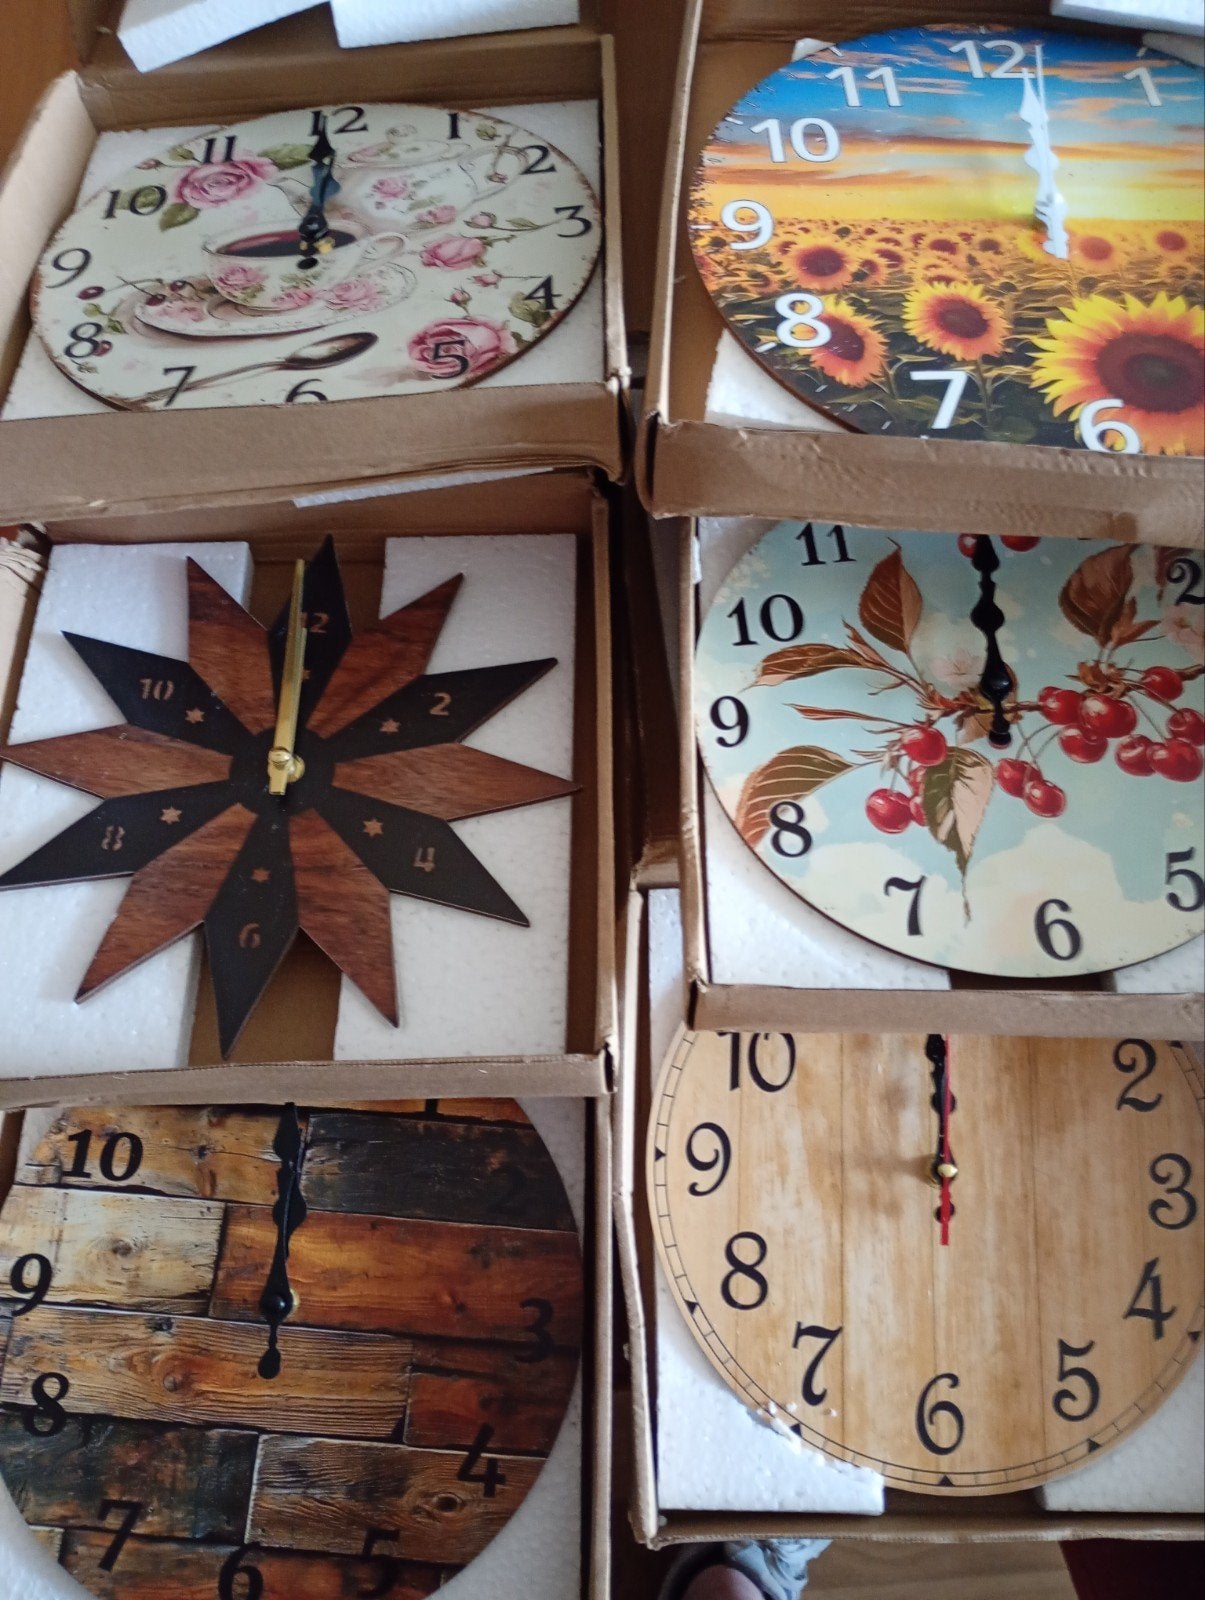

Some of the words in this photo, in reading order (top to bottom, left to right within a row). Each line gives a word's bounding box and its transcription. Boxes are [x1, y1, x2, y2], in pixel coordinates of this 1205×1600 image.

[949, 40, 1034, 79] 12
[825, 67, 903, 107] 11
[1124, 67, 1162, 107] 1
[308, 106, 368, 136] 12
[446, 113, 461, 140] 1
[750, 117, 841, 163] 10
[201, 136, 238, 164] 11
[524, 146, 556, 174] 2
[103, 186, 166, 218] 10
[554, 205, 592, 238] 3
[720, 200, 773, 250] 9
[51, 248, 91, 288] 9
[524, 275, 562, 310] 4
[63, 322, 103, 358] 8
[775, 292, 832, 348] 8
[430, 339, 470, 378] 5
[162, 366, 196, 406] 7
[910, 371, 967, 429] 7
[1080, 398, 1141, 454] 6
[795, 522, 857, 567] 11
[1166, 557, 1205, 606] 2
[727, 594, 803, 646] 10
[139, 678, 173, 699] 10
[430, 692, 451, 716] 2
[710, 696, 749, 748] 9
[102, 825, 126, 849] 8
[769, 801, 812, 857] 8
[414, 847, 435, 871] 4
[1165, 846, 1205, 912] 5
[884, 875, 927, 936] 7
[1035, 899, 1081, 960] 6
[239, 922, 261, 949] 6
[718, 1032, 796, 1092] 10
[1113, 1038, 1162, 1112] 2
[63, 1129, 144, 1181] 10
[686, 1122, 731, 1196] 9
[1149, 1153, 1196, 1230] 3
[10, 1254, 52, 1317] 9
[720, 1232, 768, 1310] 8
[1124, 1257, 1176, 1339] 4
[515, 1298, 553, 1363] 3
[792, 1321, 843, 1406] 7
[1052, 1339, 1101, 1421] 5
[23, 1372, 70, 1436] 8
[916, 1373, 965, 1455] 6
[458, 1424, 505, 1499] 4
[100, 1501, 140, 1571] 7
[356, 1526, 400, 1598] 5
[218, 1546, 263, 1600] 6
